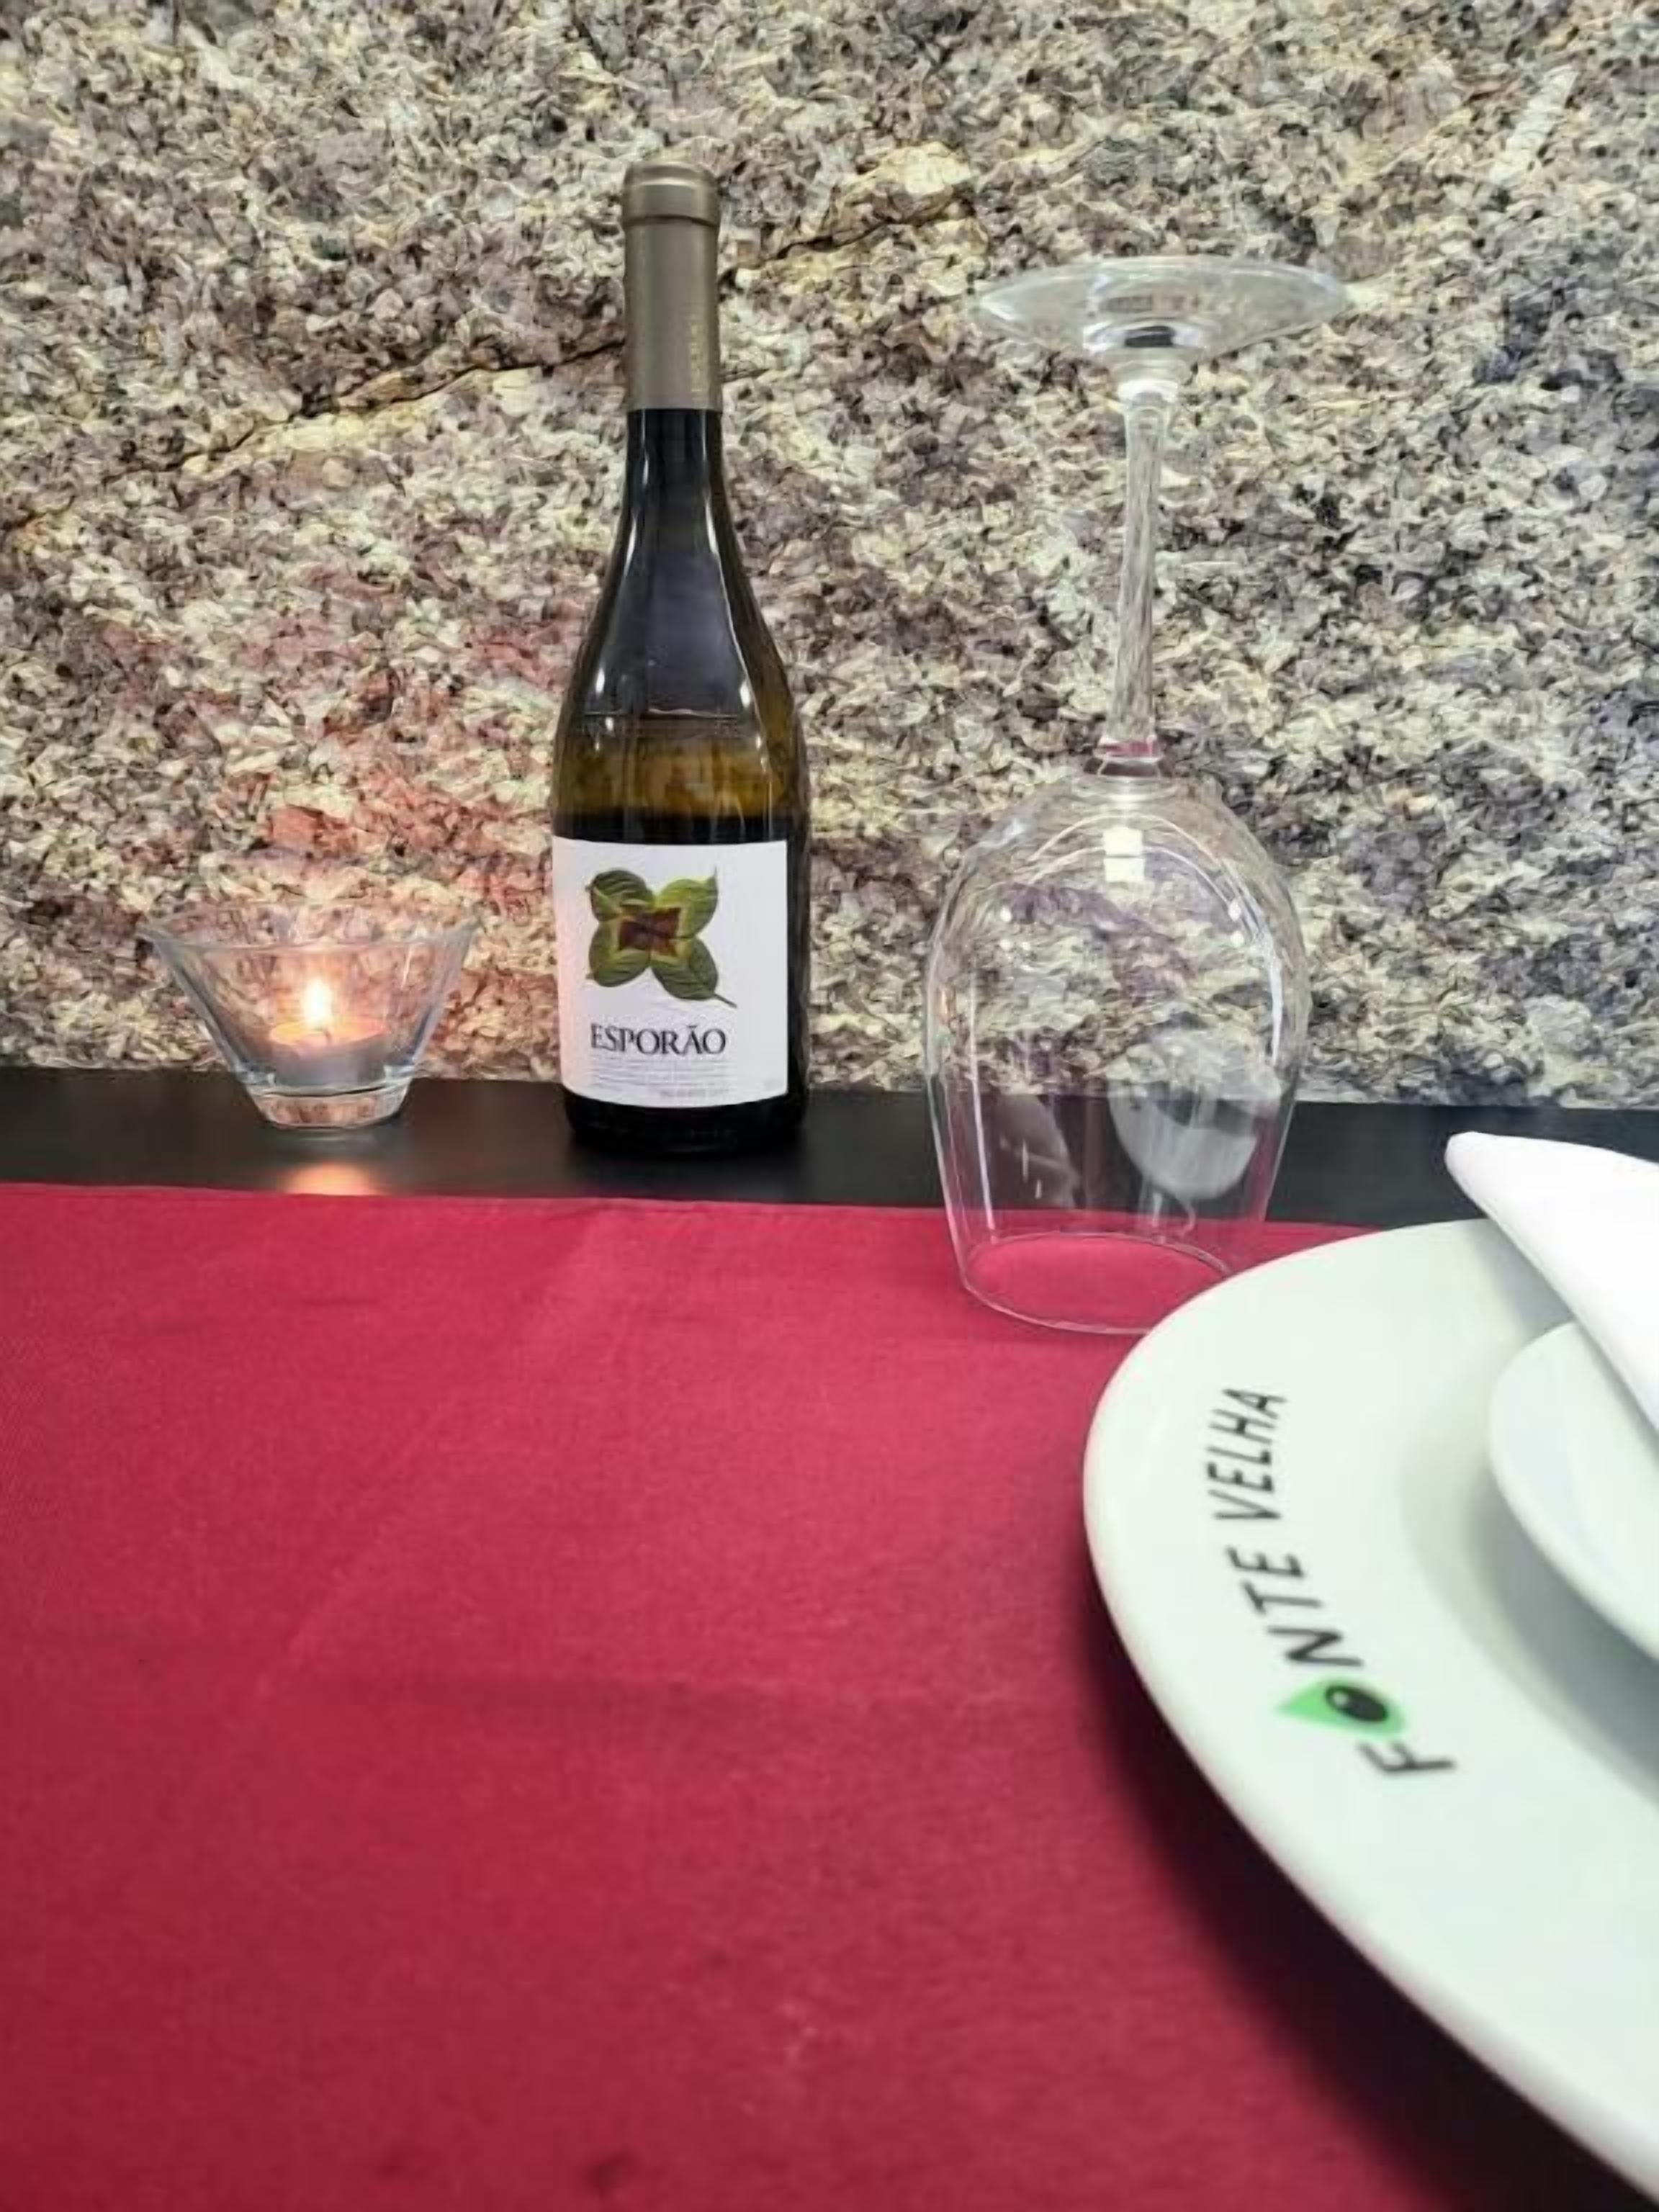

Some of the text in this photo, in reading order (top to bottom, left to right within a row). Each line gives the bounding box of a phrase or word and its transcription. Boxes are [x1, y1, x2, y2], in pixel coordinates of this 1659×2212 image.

[590, 1022, 727, 1056] ESPORÃO
[1205, 1388, 1457, 1776] FONTE VELHA
